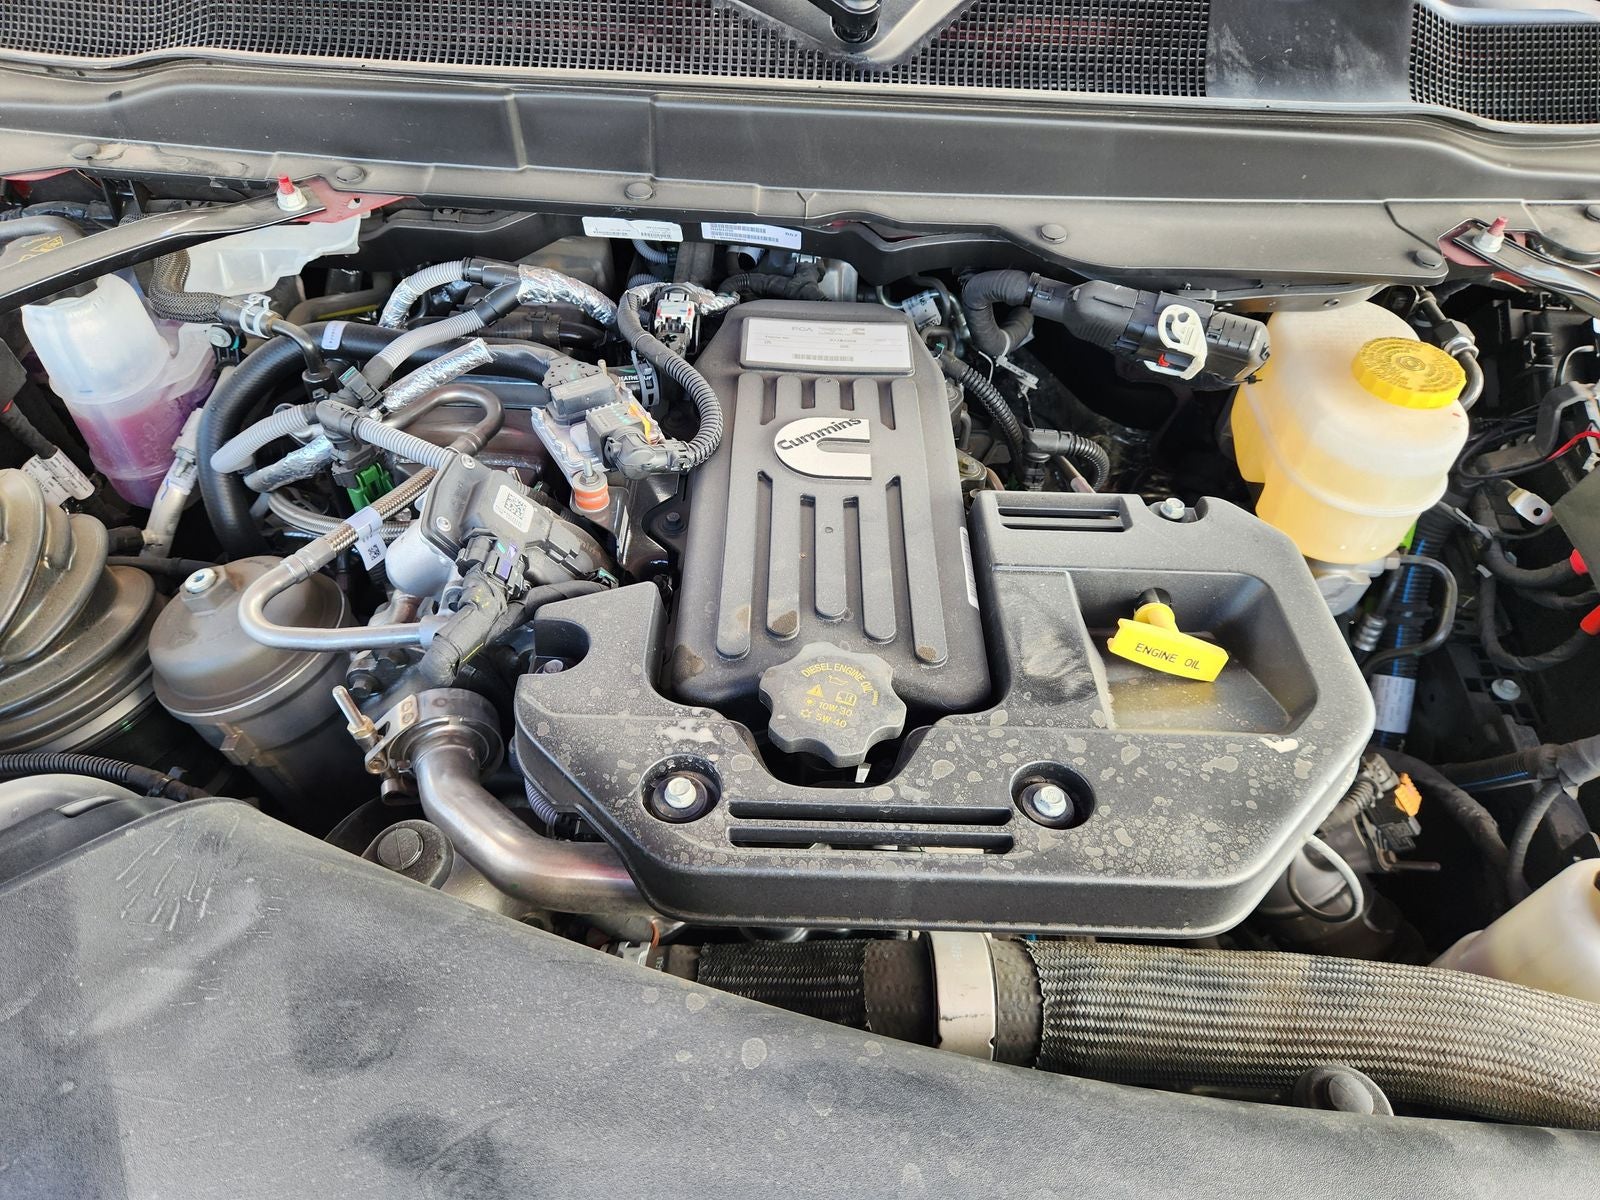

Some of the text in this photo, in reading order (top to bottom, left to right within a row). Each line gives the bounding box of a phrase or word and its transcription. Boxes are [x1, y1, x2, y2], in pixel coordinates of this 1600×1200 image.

[776, 418, 862, 450] Cummins
[1135, 642, 1201, 670] ENGINE OIL
[801, 663, 832, 678] DIESEL
[834, 663, 866, 682] ENGINE
[819, 702, 852, 717] 10W-30
[816, 712, 847, 728] 5W-40
